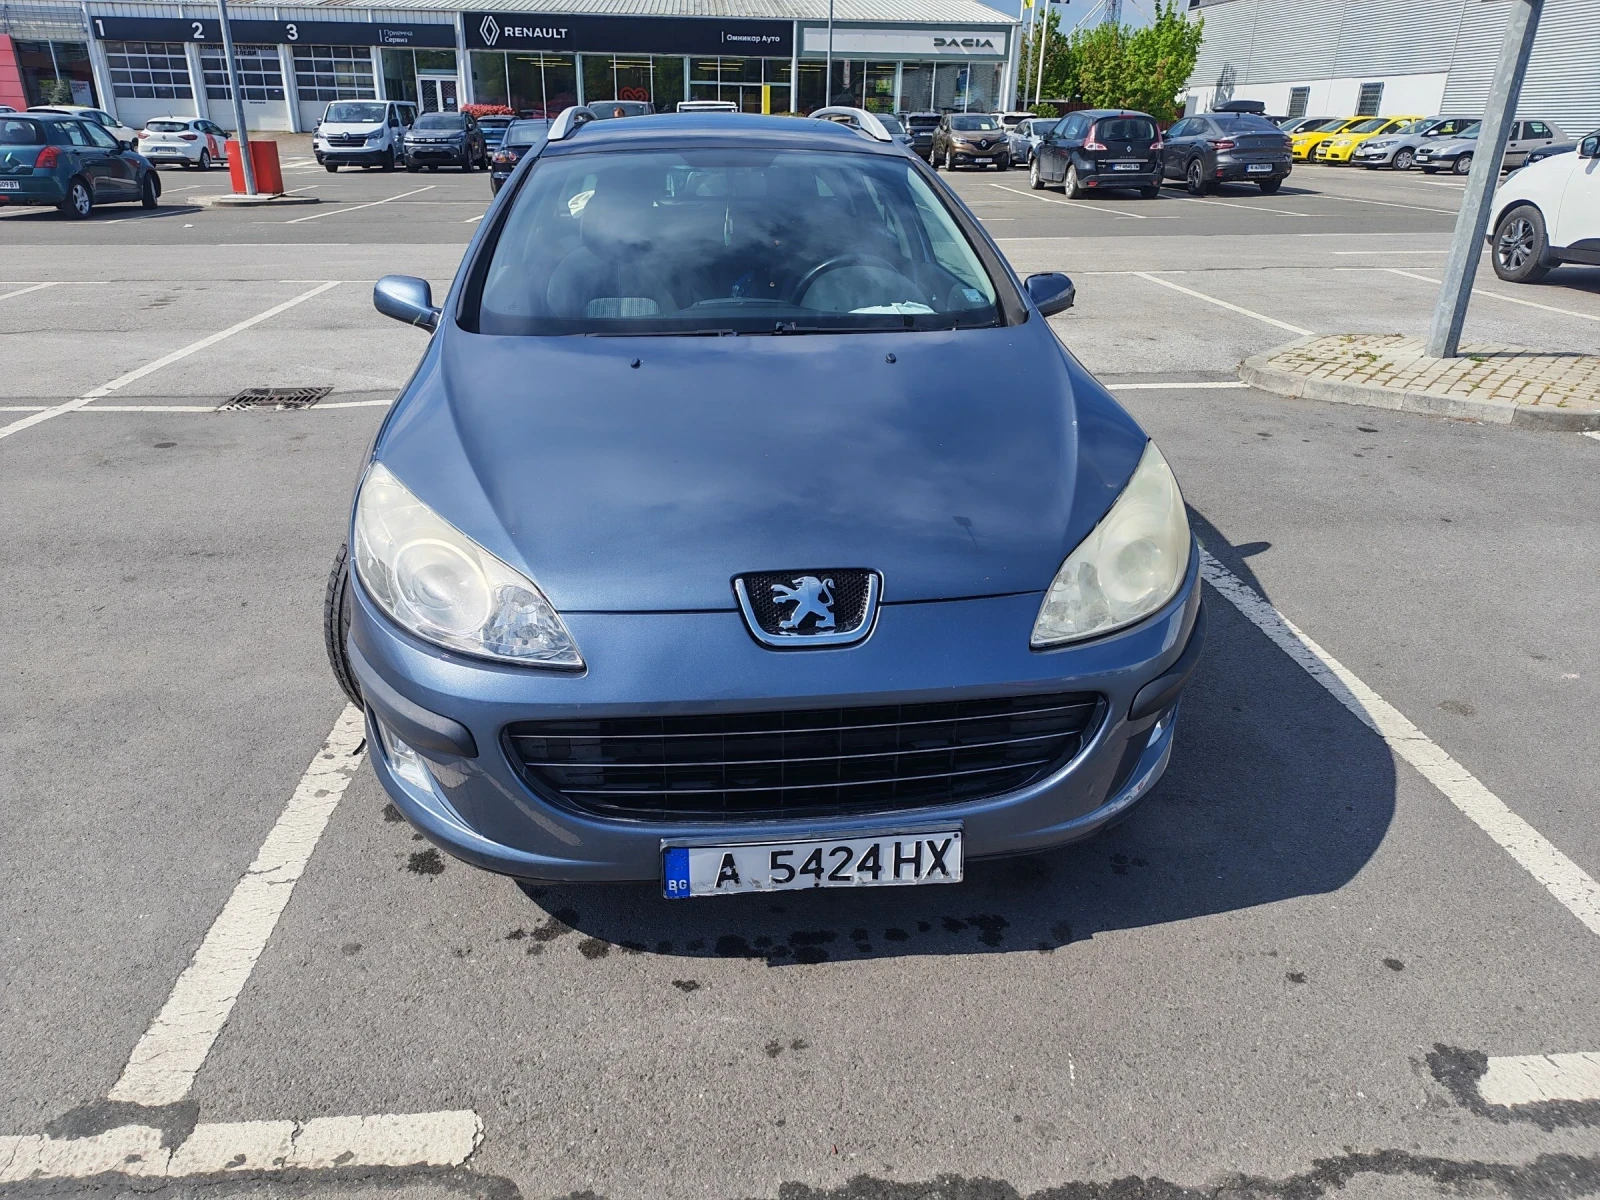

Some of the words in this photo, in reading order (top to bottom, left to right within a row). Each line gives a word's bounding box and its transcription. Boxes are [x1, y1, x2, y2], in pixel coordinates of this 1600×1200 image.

[95, 19, 105, 37] 1
[191, 22, 205, 39] 2
[286, 23, 299, 41] 3
[504, 26, 568, 39] RENAULT
[384, 36, 408, 44] Сервиз
[726, 34, 761, 43] Омникар
[761, 35, 780, 44] Ауто
[933, 37, 994, 48] DACIA
[714, 852, 740, 889] A
[668, 879, 688, 892] BG
